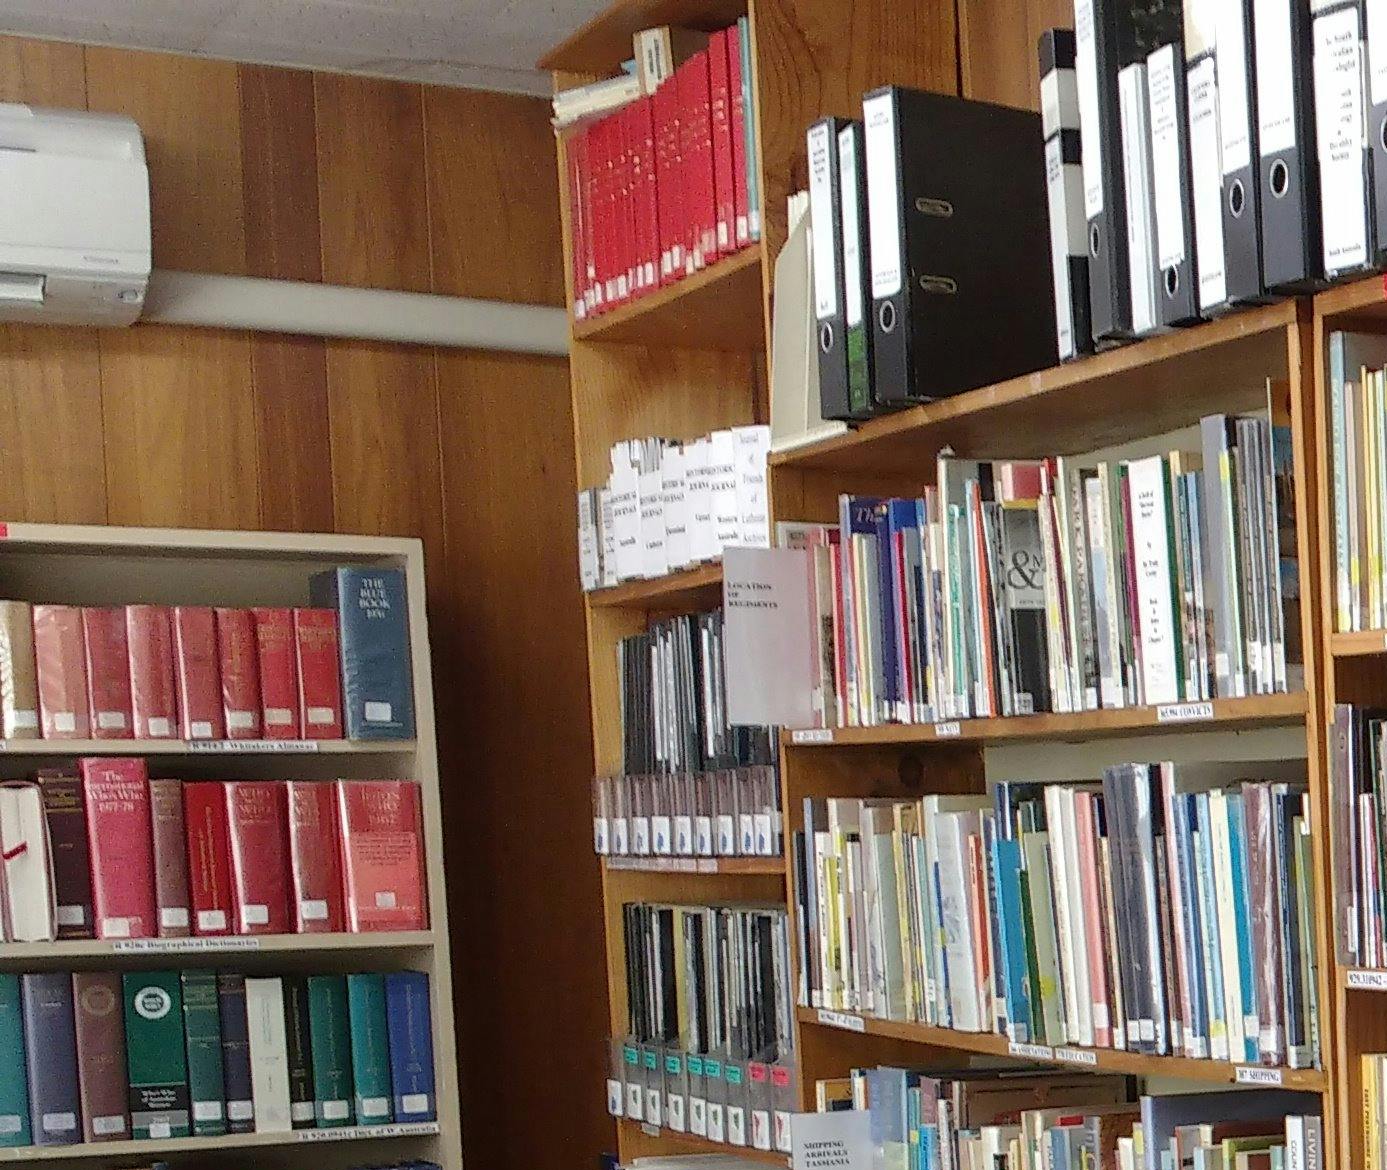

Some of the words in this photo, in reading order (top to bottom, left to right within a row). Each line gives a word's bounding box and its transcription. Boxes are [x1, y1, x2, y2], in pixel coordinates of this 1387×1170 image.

[803, 1141, 845, 1150] SHIPPING
[804, 1150, 849, 1159] ARRIVALS
[805, 1158, 851, 1168] TASMANIA
